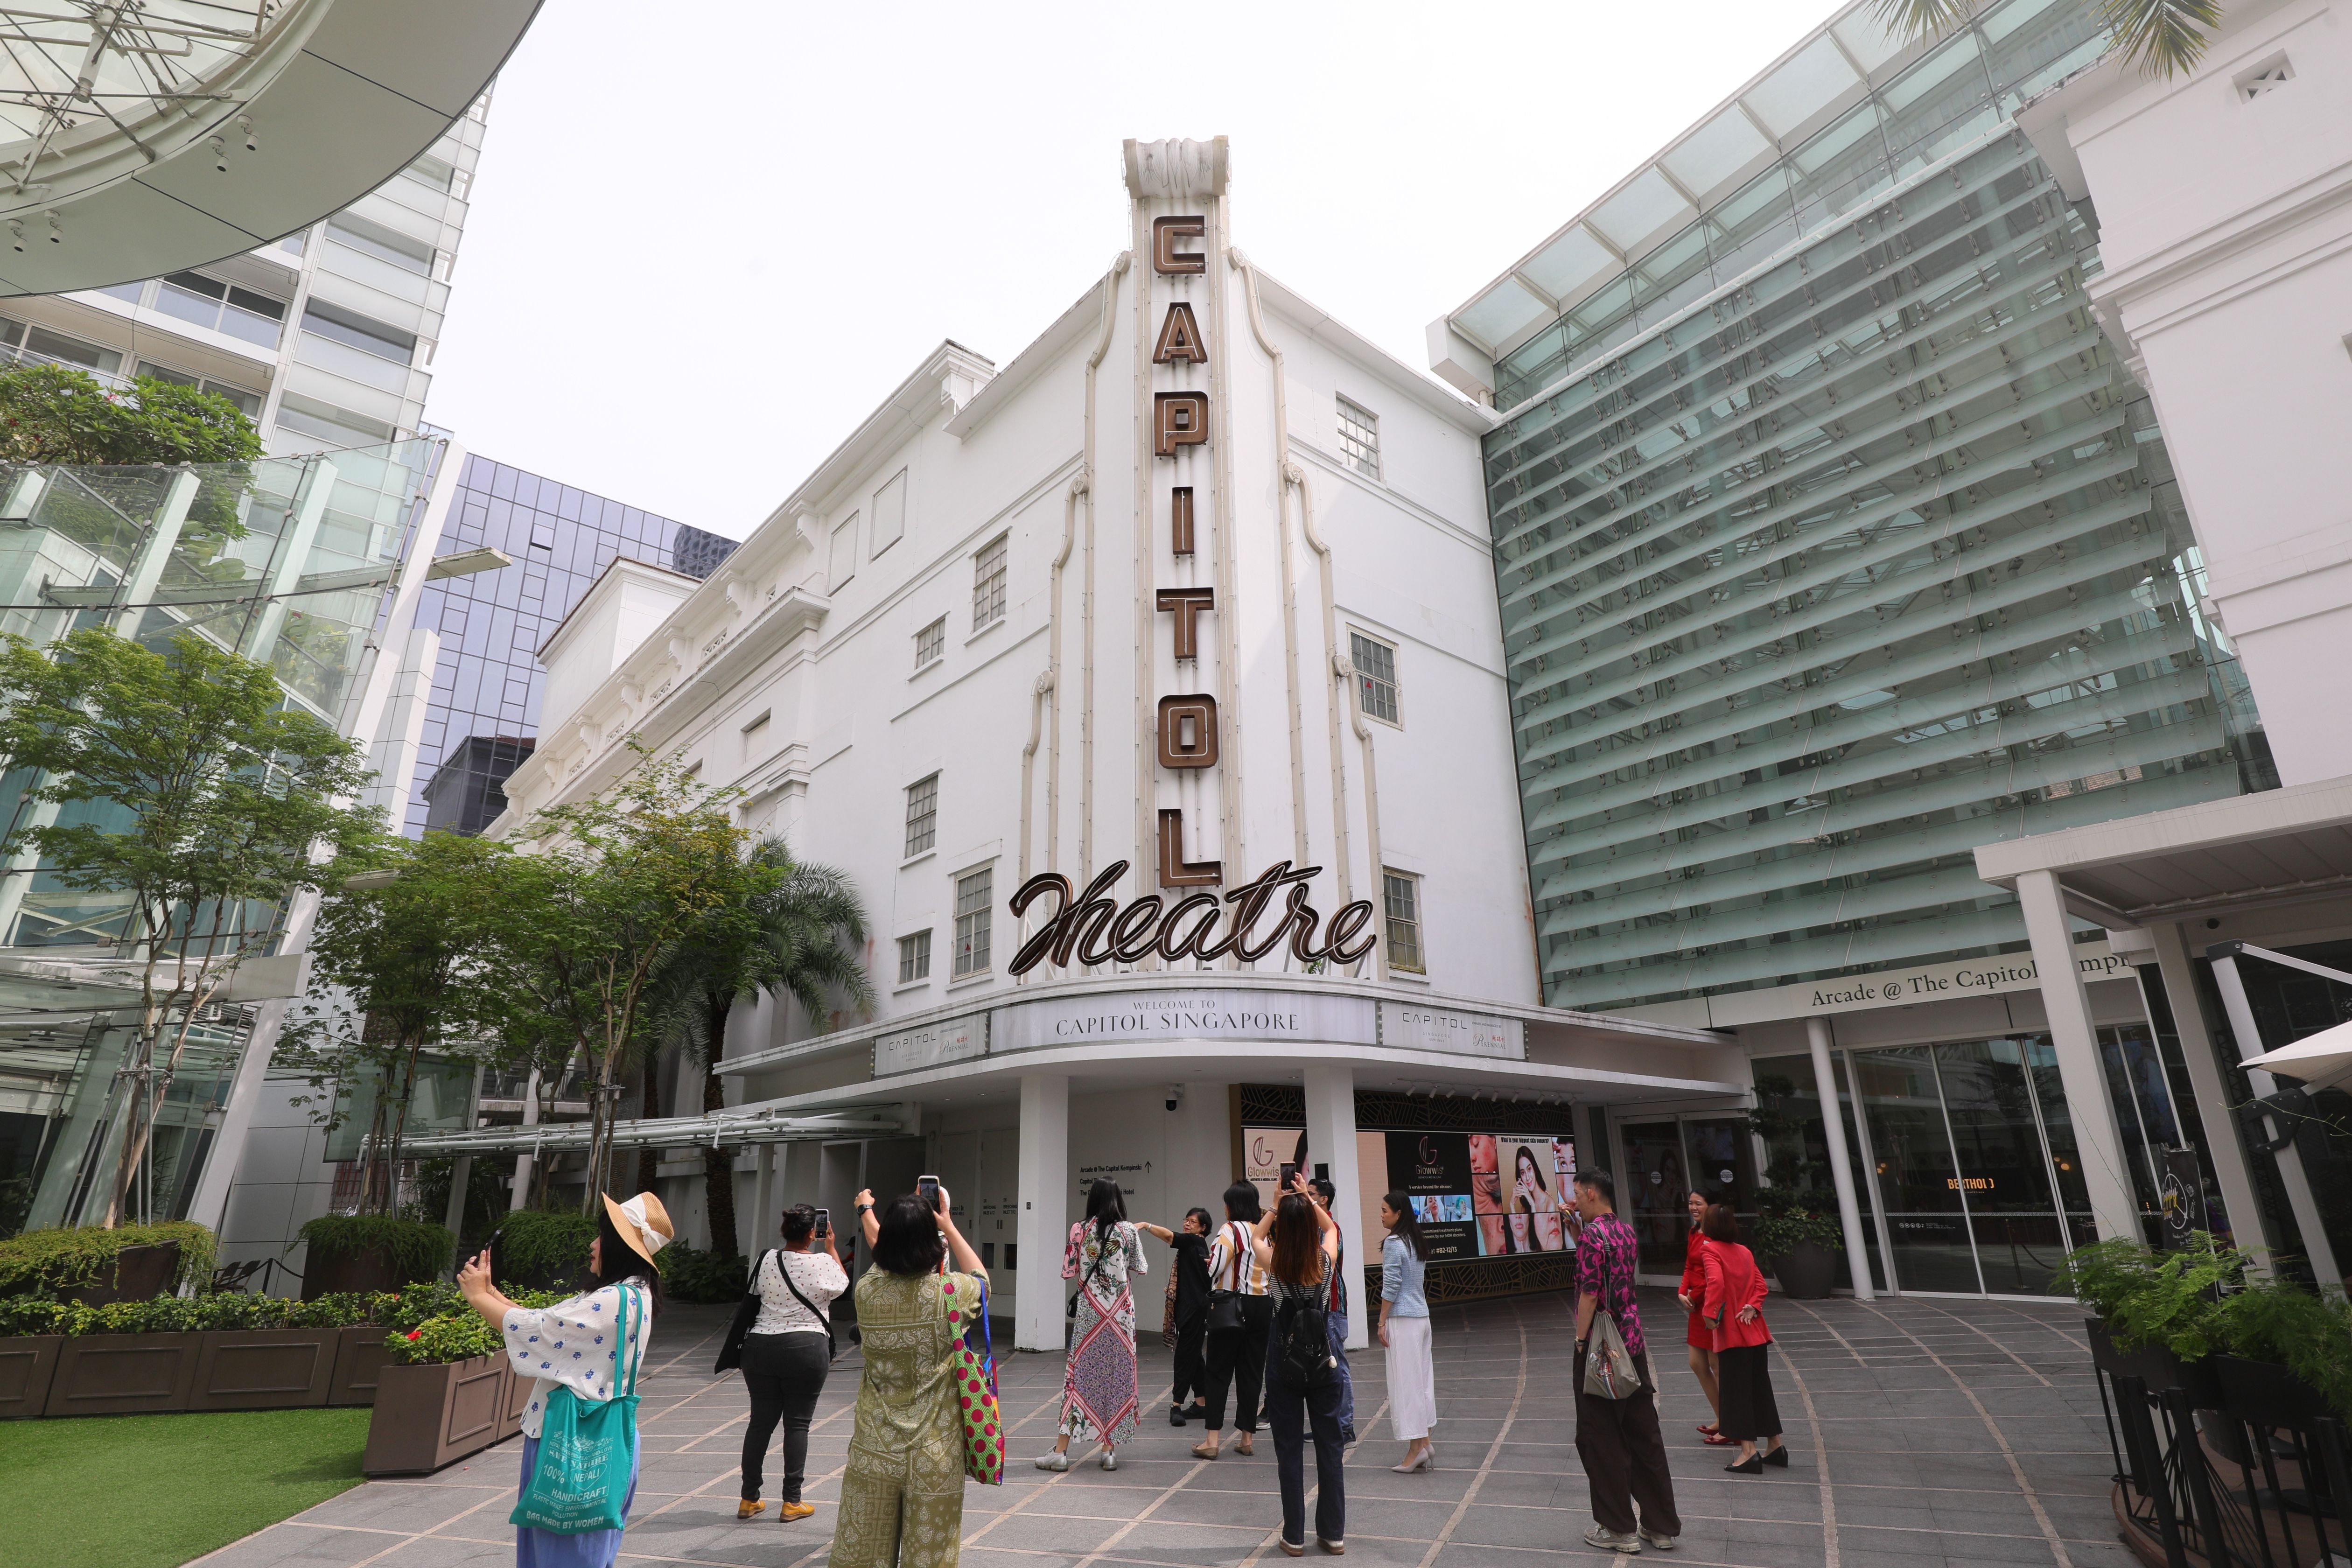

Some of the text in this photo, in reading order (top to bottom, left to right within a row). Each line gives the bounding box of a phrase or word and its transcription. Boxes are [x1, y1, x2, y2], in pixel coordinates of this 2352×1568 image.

[1153, 215, 1223, 888] CAPITOL
[1009, 860, 1377, 976] Theatre
[1812, 959, 2038, 1006] Arcade @ The Capitol
[1133, 1000, 1215, 1011] WELCOME TO
[1056, 1012, 1299, 1036] CAPITOL SINGAPORE
[1402, 1013, 1467, 1029] CAPITOL
[889, 1032, 937, 1050] CAPITOL
[1247, 1166, 1279, 1176] Glowwis
[1436, 1246, 1457, 1254] #B2-12/13
[570, 1454, 608, 1470] NATURE
[544, 1463, 600, 1484] 100% NEPALI
[533, 1493, 607, 1511] PLASTIC MAKES ENVIRONMENTAL
[551, 1486, 607, 1502] HANDICRAFT
[526, 1511, 540, 1521] BAG
[542, 1516, 560, 1528] MADE
[575, 1516, 604, 1528] WOMEN
